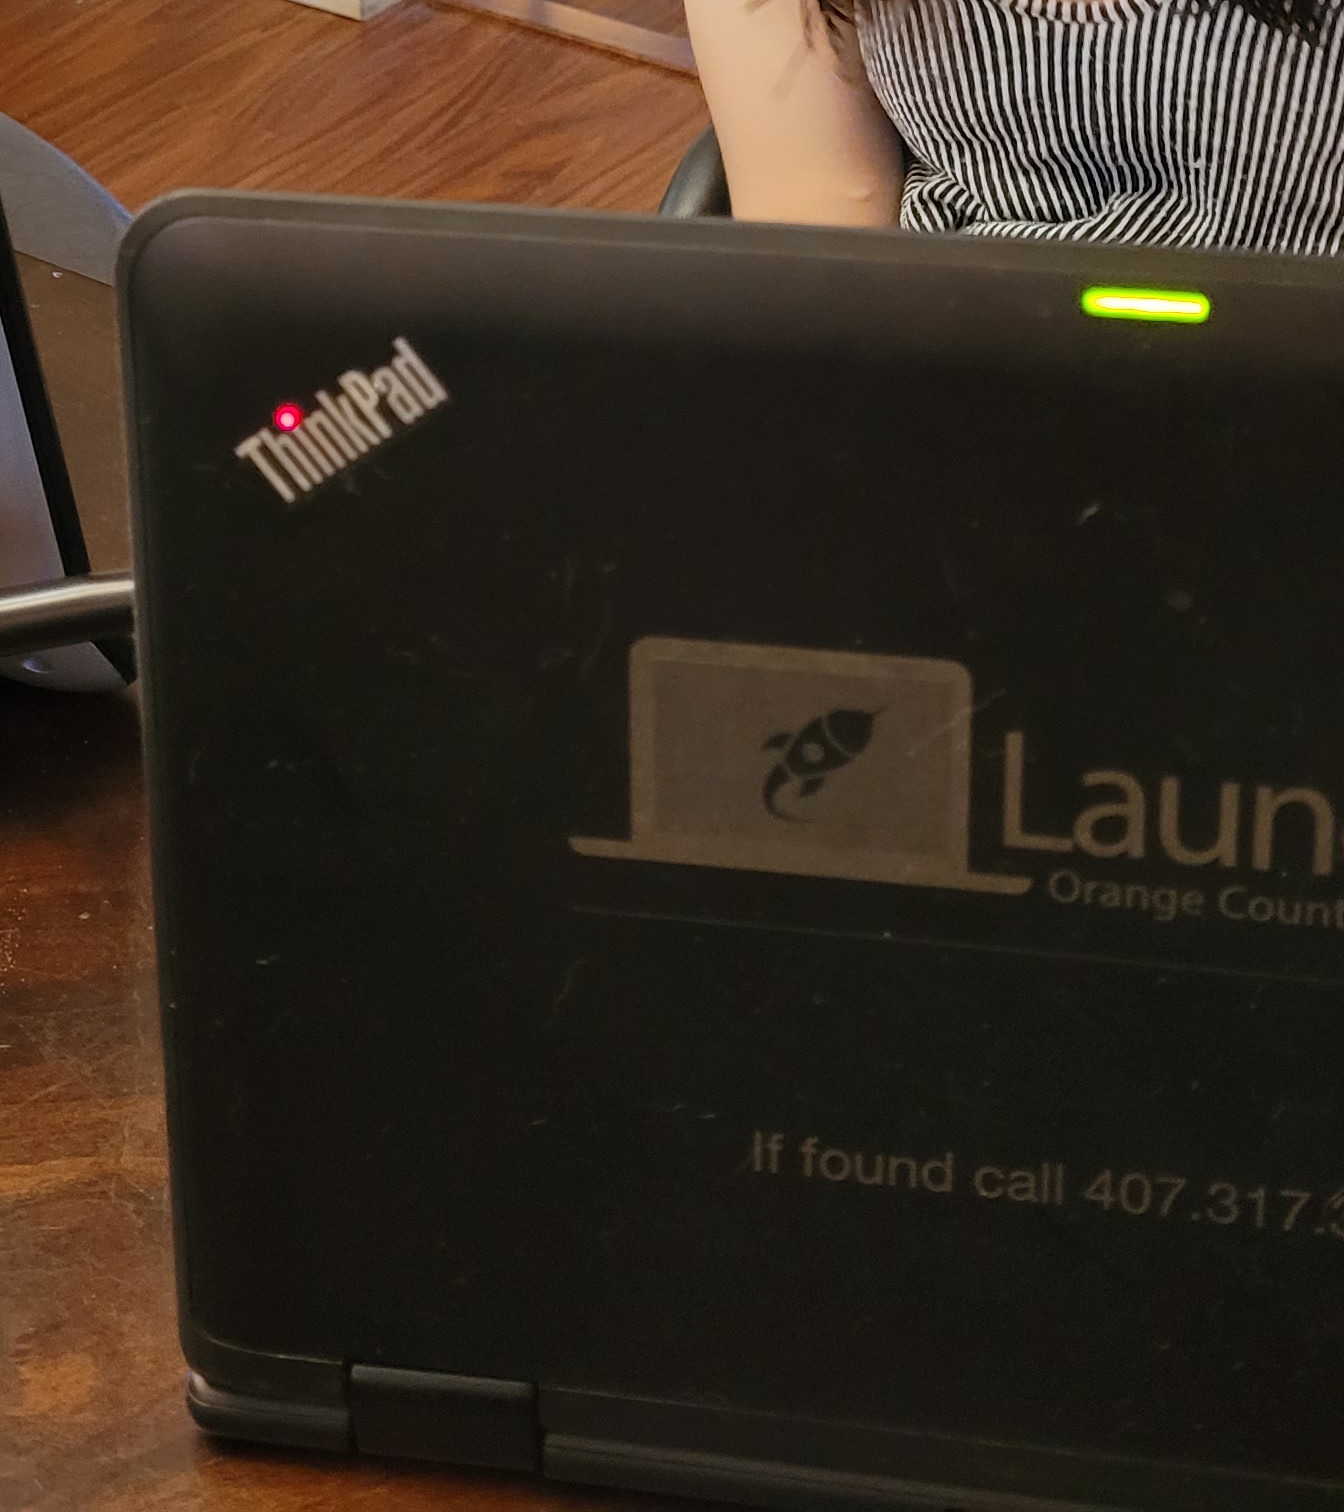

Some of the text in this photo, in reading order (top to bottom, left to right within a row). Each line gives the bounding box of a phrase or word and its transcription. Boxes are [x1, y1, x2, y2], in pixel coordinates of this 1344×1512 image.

[233, 336, 449, 504] ThinkPad
[1047, 870, 1205, 923] Orange
[751, 1131, 786, 1175] If
[798, 1135, 955, 1192] found
[973, 1163, 1064, 1207] call
